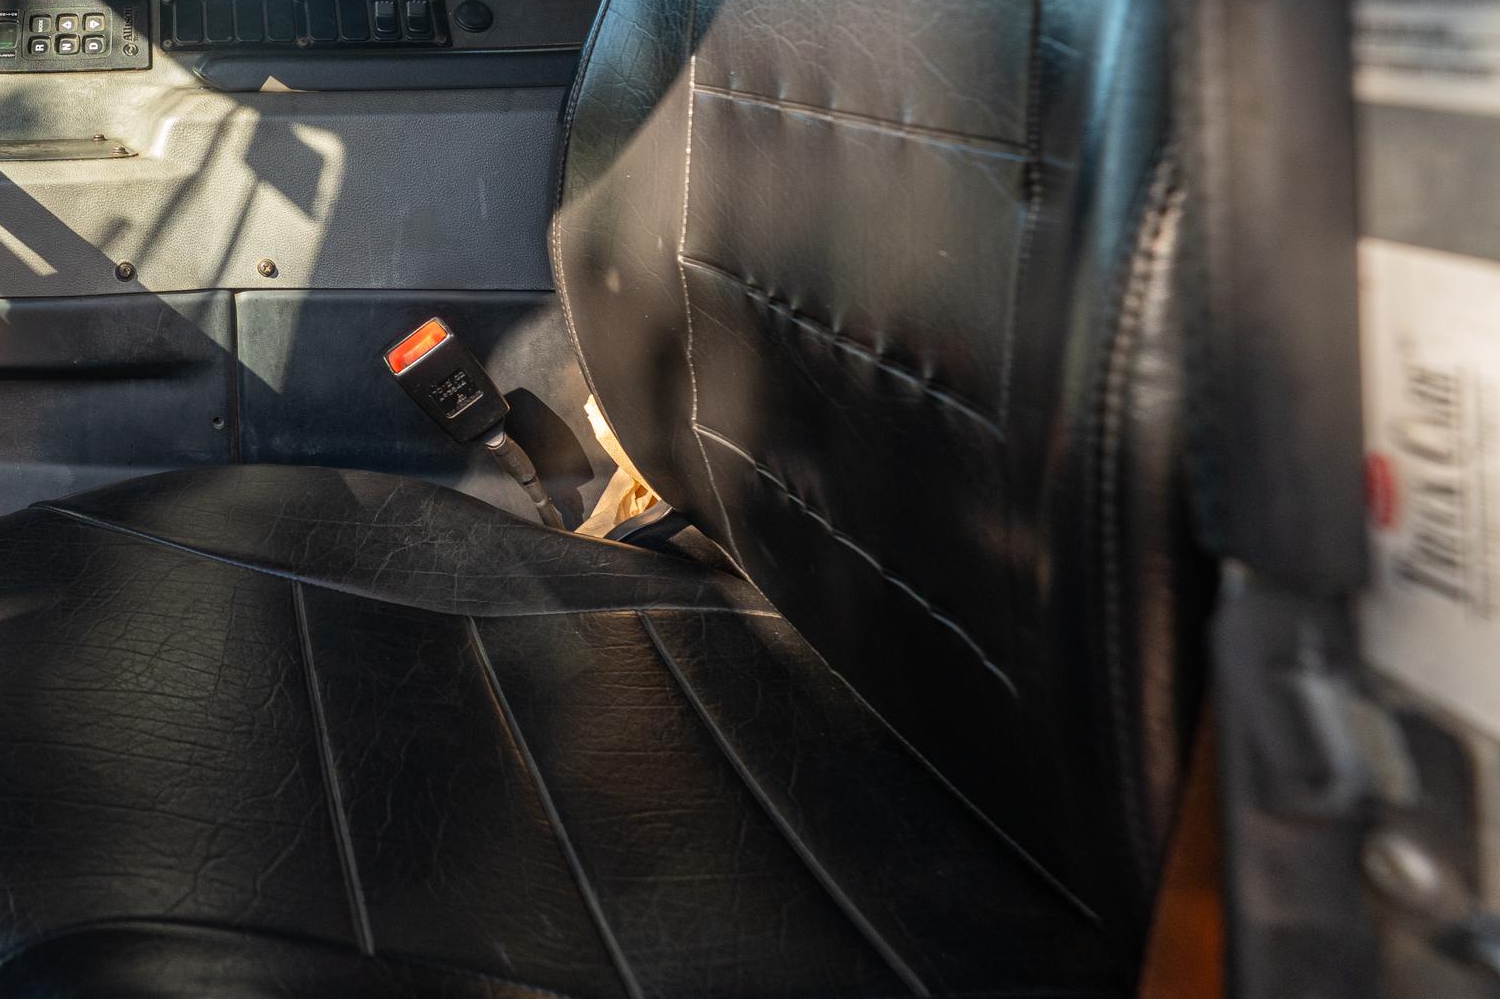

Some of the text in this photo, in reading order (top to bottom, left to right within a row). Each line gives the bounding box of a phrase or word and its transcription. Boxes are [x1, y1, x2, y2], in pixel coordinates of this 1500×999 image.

[122, 7, 133, 42] Allison
[62, 43, 72, 51] N
[89, 42, 99, 50] D
